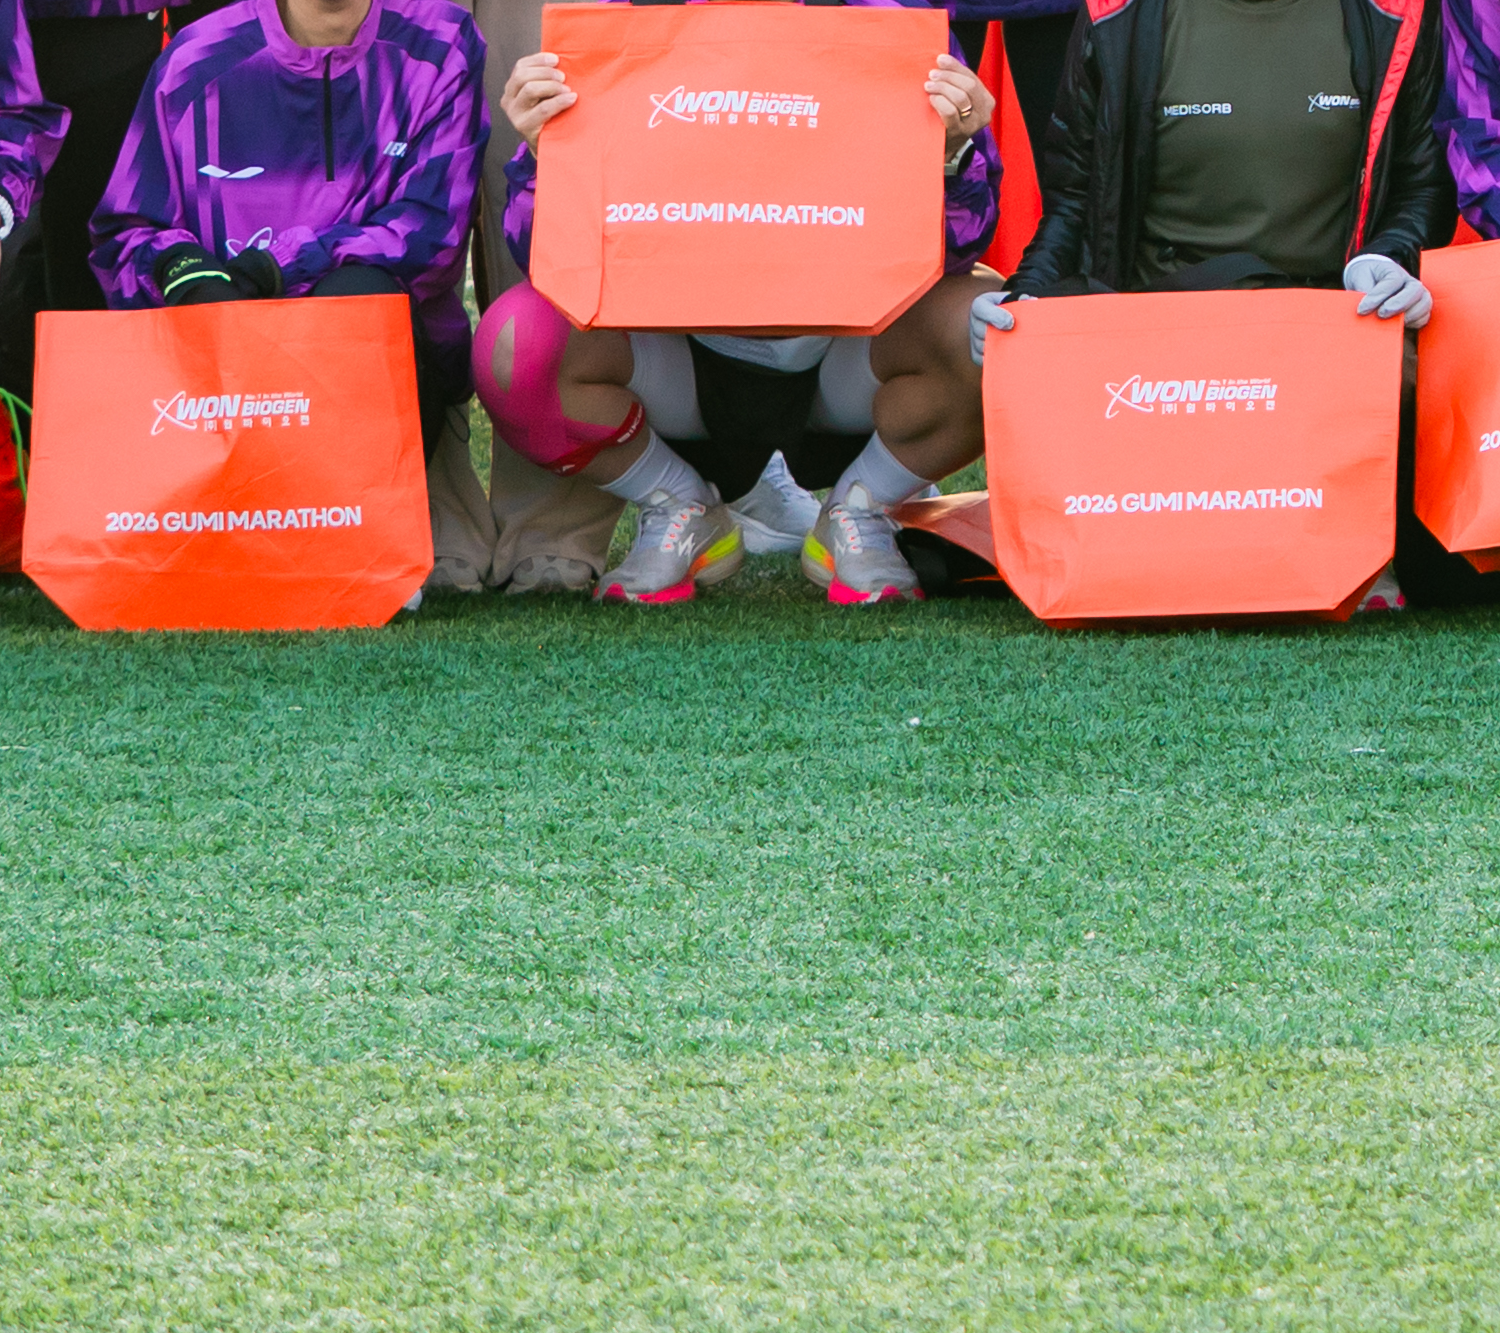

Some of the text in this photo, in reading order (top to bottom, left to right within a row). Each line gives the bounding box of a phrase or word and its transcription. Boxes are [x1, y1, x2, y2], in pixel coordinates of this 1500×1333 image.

[675, 91, 820, 116] WON BIOGEN
[1163, 102, 1232, 117] MEDISORB
[1318, 95, 1351, 107] WON
[606, 202, 864, 226] 2026 GUMI MARATHON
[1130, 380, 1278, 403] WON BIOGEN
[176, 395, 310, 419] WON BIOGEN
[1064, 488, 1323, 515] 2026 GUMI MARATHON
[105, 505, 362, 533] 2026 GUMI MARATHON
